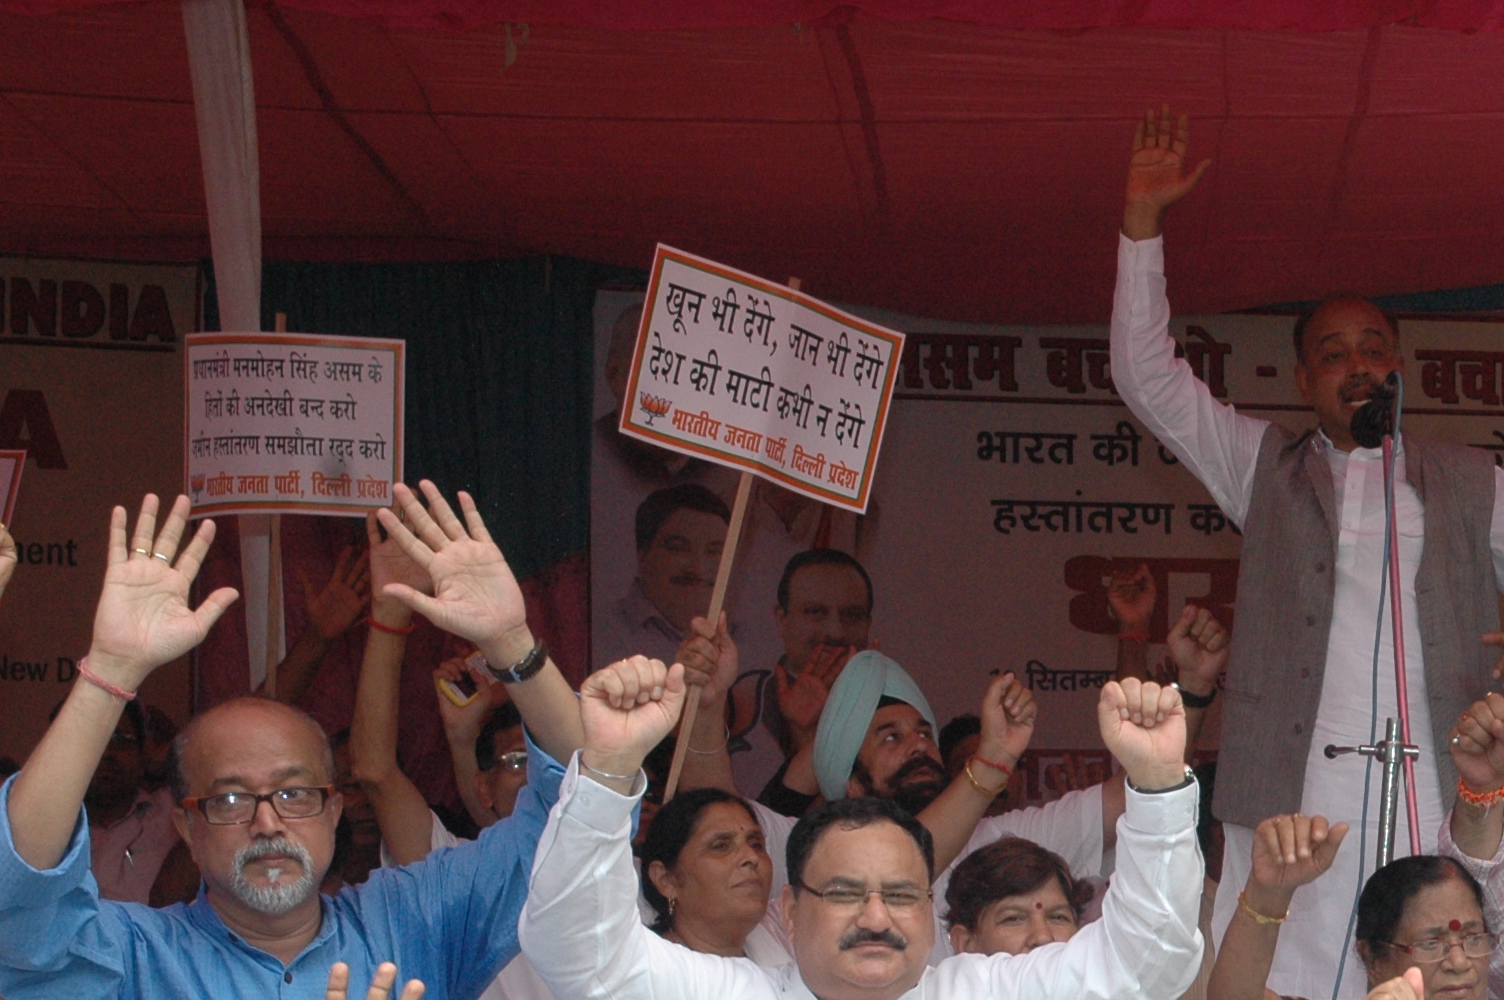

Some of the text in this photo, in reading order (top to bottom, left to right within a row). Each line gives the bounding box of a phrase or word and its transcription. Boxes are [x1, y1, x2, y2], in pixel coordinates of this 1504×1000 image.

[0, 277, 177, 342] NDIA
[666, 283, 884, 389] खून भी देंगे, जान भी देंगे
[193, 350, 383, 383] प्रधानमंत्री मनमोहन सिंह असम के
[205, 389, 357, 420] हितों की अनदेखी बन्द करो
[649, 332, 865, 448] देश की माटी कभी न देंगे
[192, 430, 211, 458] जमीन
[213, 429, 260, 460] हस्तांतरण
[265, 427, 324, 457] समझौता
[359, 433, 386, 460] करो
[673, 409, 859, 490] भारतीय जनता पार्टी, दिल्ली प्रदेश
[977, 430, 1077, 464] भारत
[1090, 421, 1142, 466] की
[207, 470, 388, 498] भारतीय जनता पार्टी, दिल्ली प्रदेश
[991, 490, 1175, 534] हस्तांतरण
